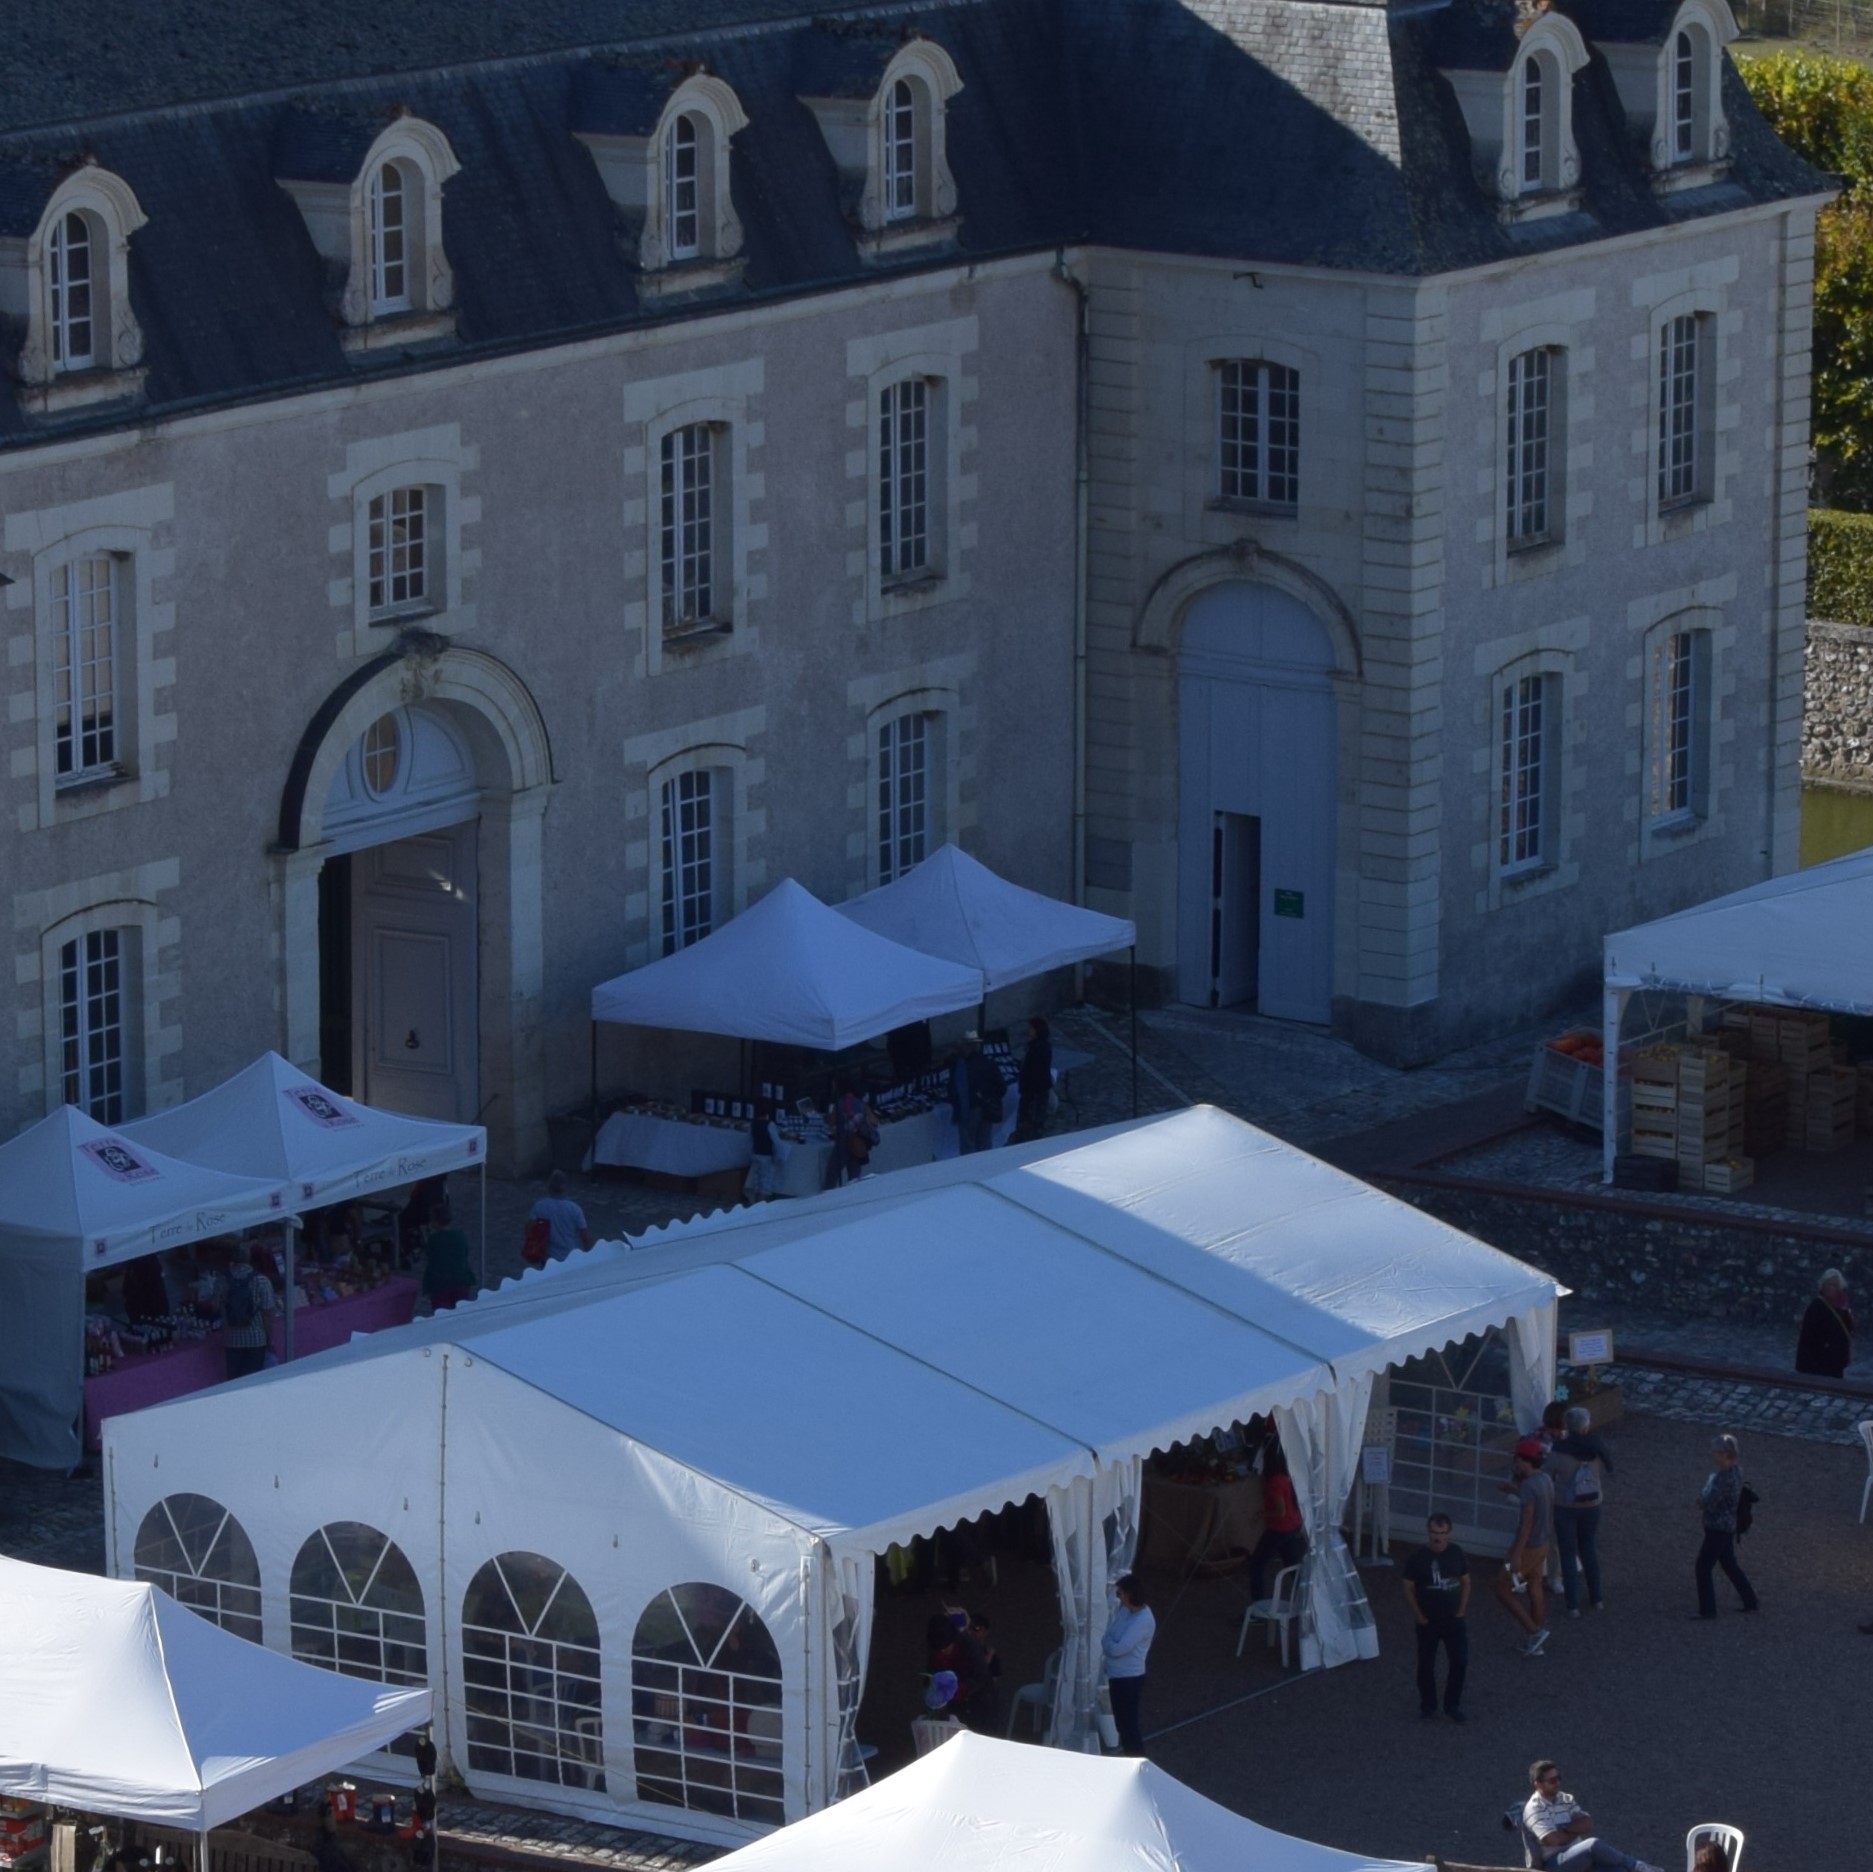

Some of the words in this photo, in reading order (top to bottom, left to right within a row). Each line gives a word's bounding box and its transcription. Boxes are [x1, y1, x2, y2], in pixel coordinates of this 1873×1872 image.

[353, 1169, 385, 1188] Terre
[397, 1157, 427, 1177] Rose
[149, 1224, 182, 1244] Terre
[195, 1211, 226, 1232] Rose
